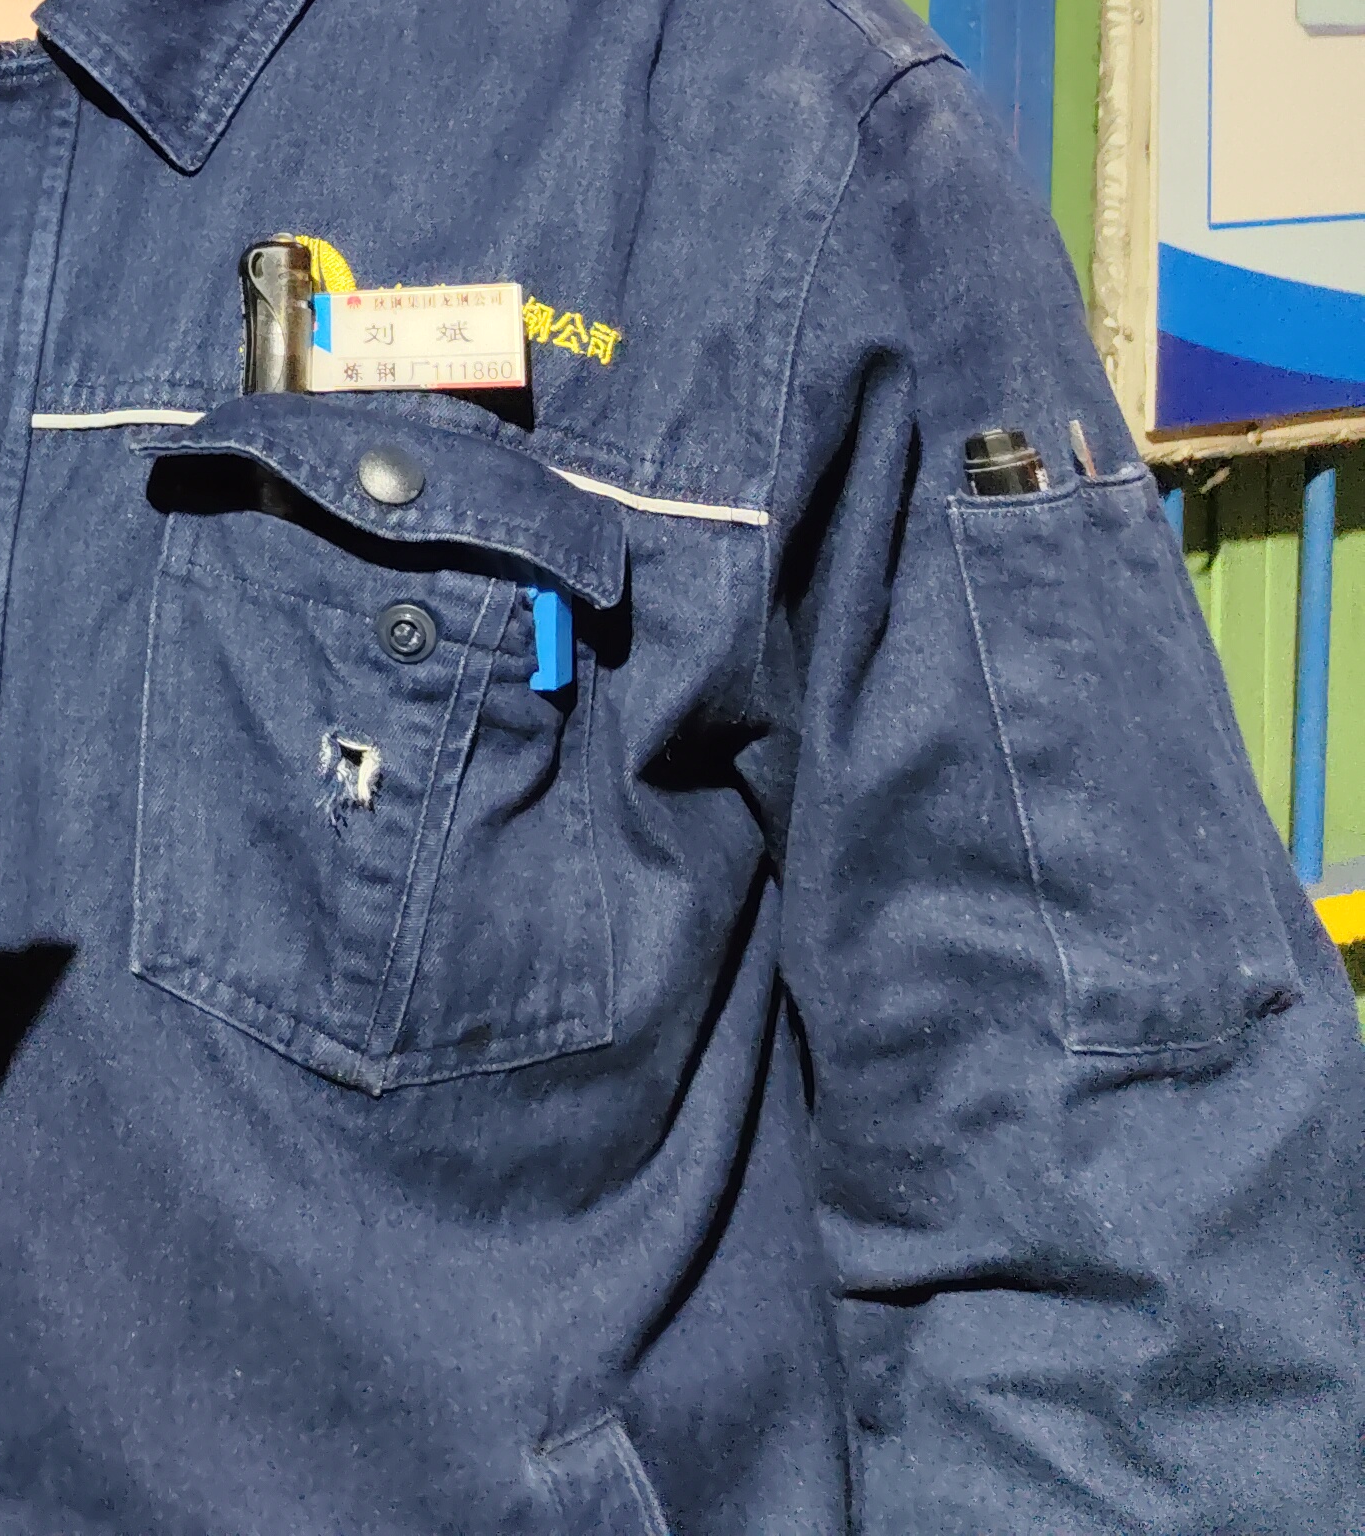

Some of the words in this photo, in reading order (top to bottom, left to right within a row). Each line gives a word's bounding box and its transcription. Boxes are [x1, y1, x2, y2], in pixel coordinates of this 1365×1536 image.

[364, 321, 473, 346] 刘斌
[342, 361, 430, 383] 炼钢厂
